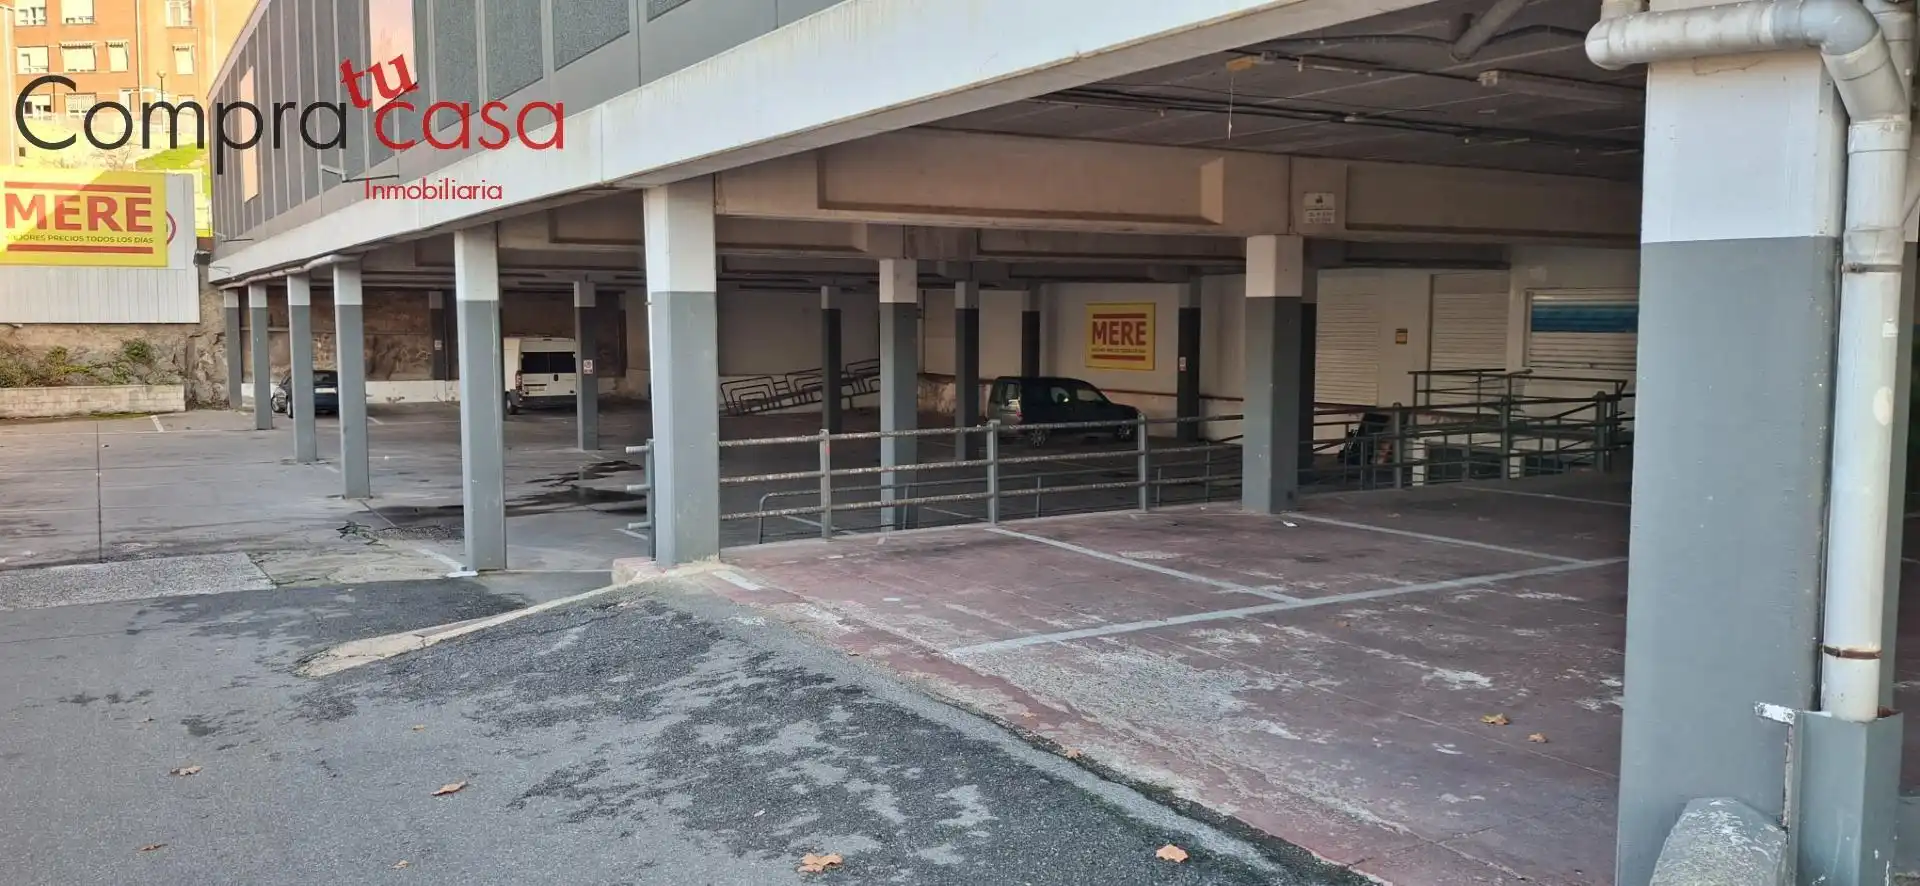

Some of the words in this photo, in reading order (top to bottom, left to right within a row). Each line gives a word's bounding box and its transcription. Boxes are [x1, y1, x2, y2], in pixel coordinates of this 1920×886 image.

[5, 193, 154, 233] MERE
[6, 234, 46, 242] EJORES
[47, 234, 85, 243] PRECIOS
[86, 235, 116, 243] TODOS
[117, 236, 133, 244] LOS
[1092, 320, 1147, 346] MERE
